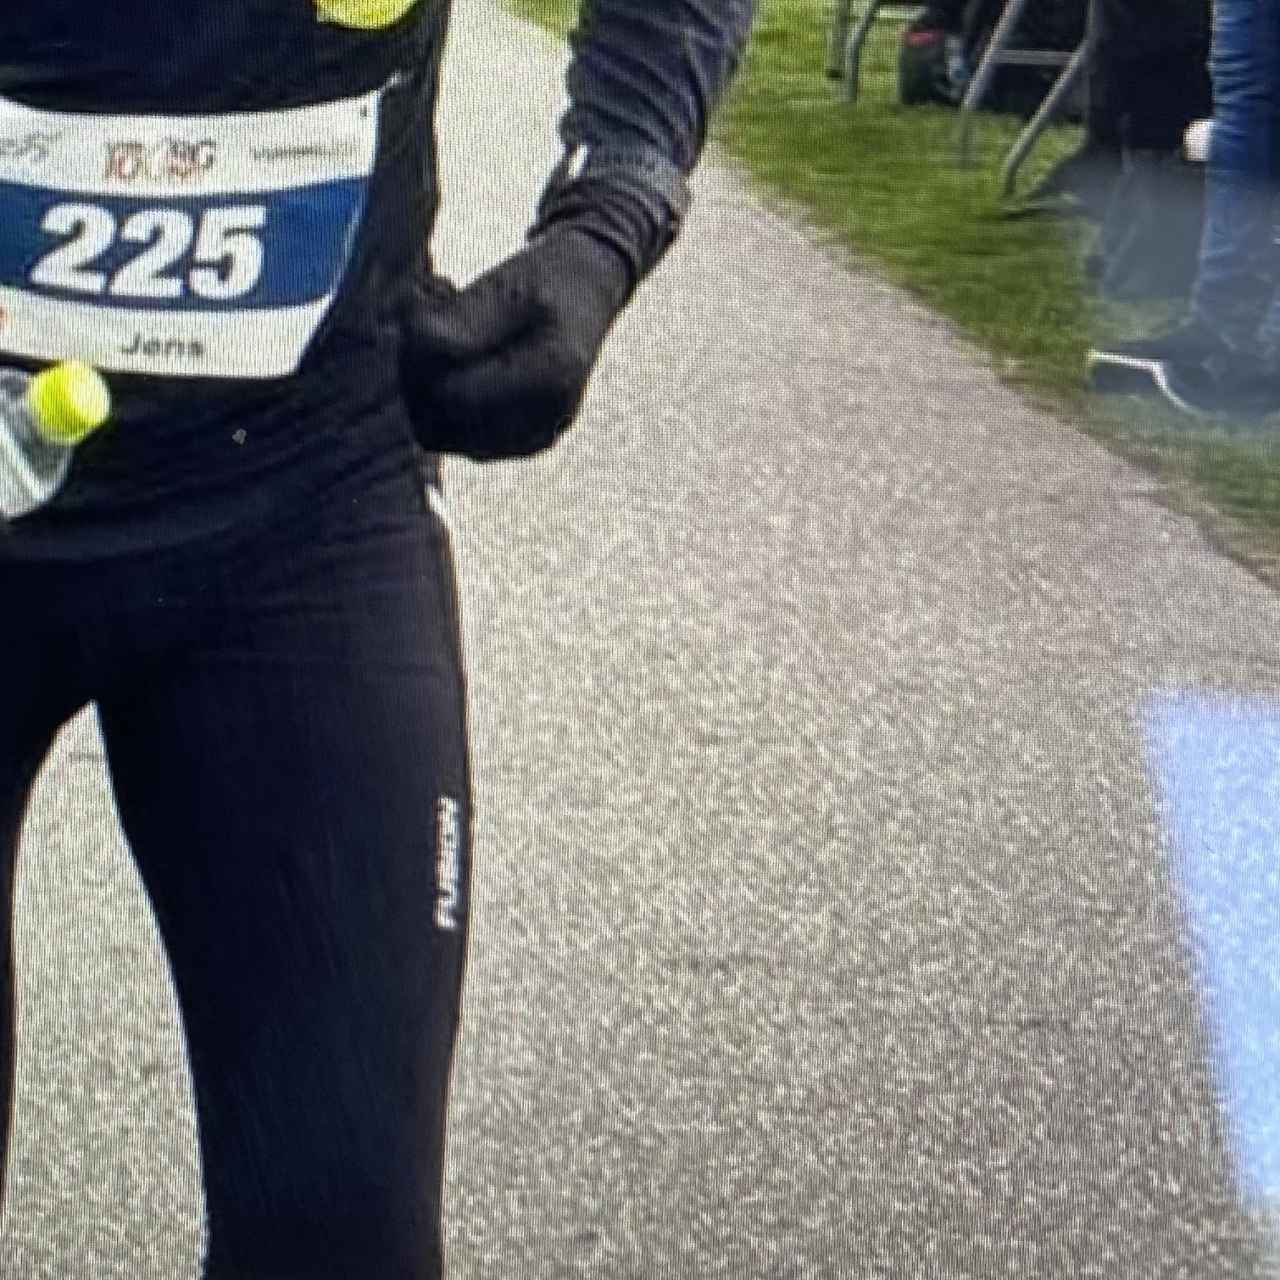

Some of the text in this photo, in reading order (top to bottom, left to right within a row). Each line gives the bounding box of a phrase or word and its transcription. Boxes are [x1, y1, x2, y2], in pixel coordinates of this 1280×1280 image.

[29, 201, 267, 300] 225
[119, 331, 205, 358] Jens
[431, 795, 461, 929] FUSION
